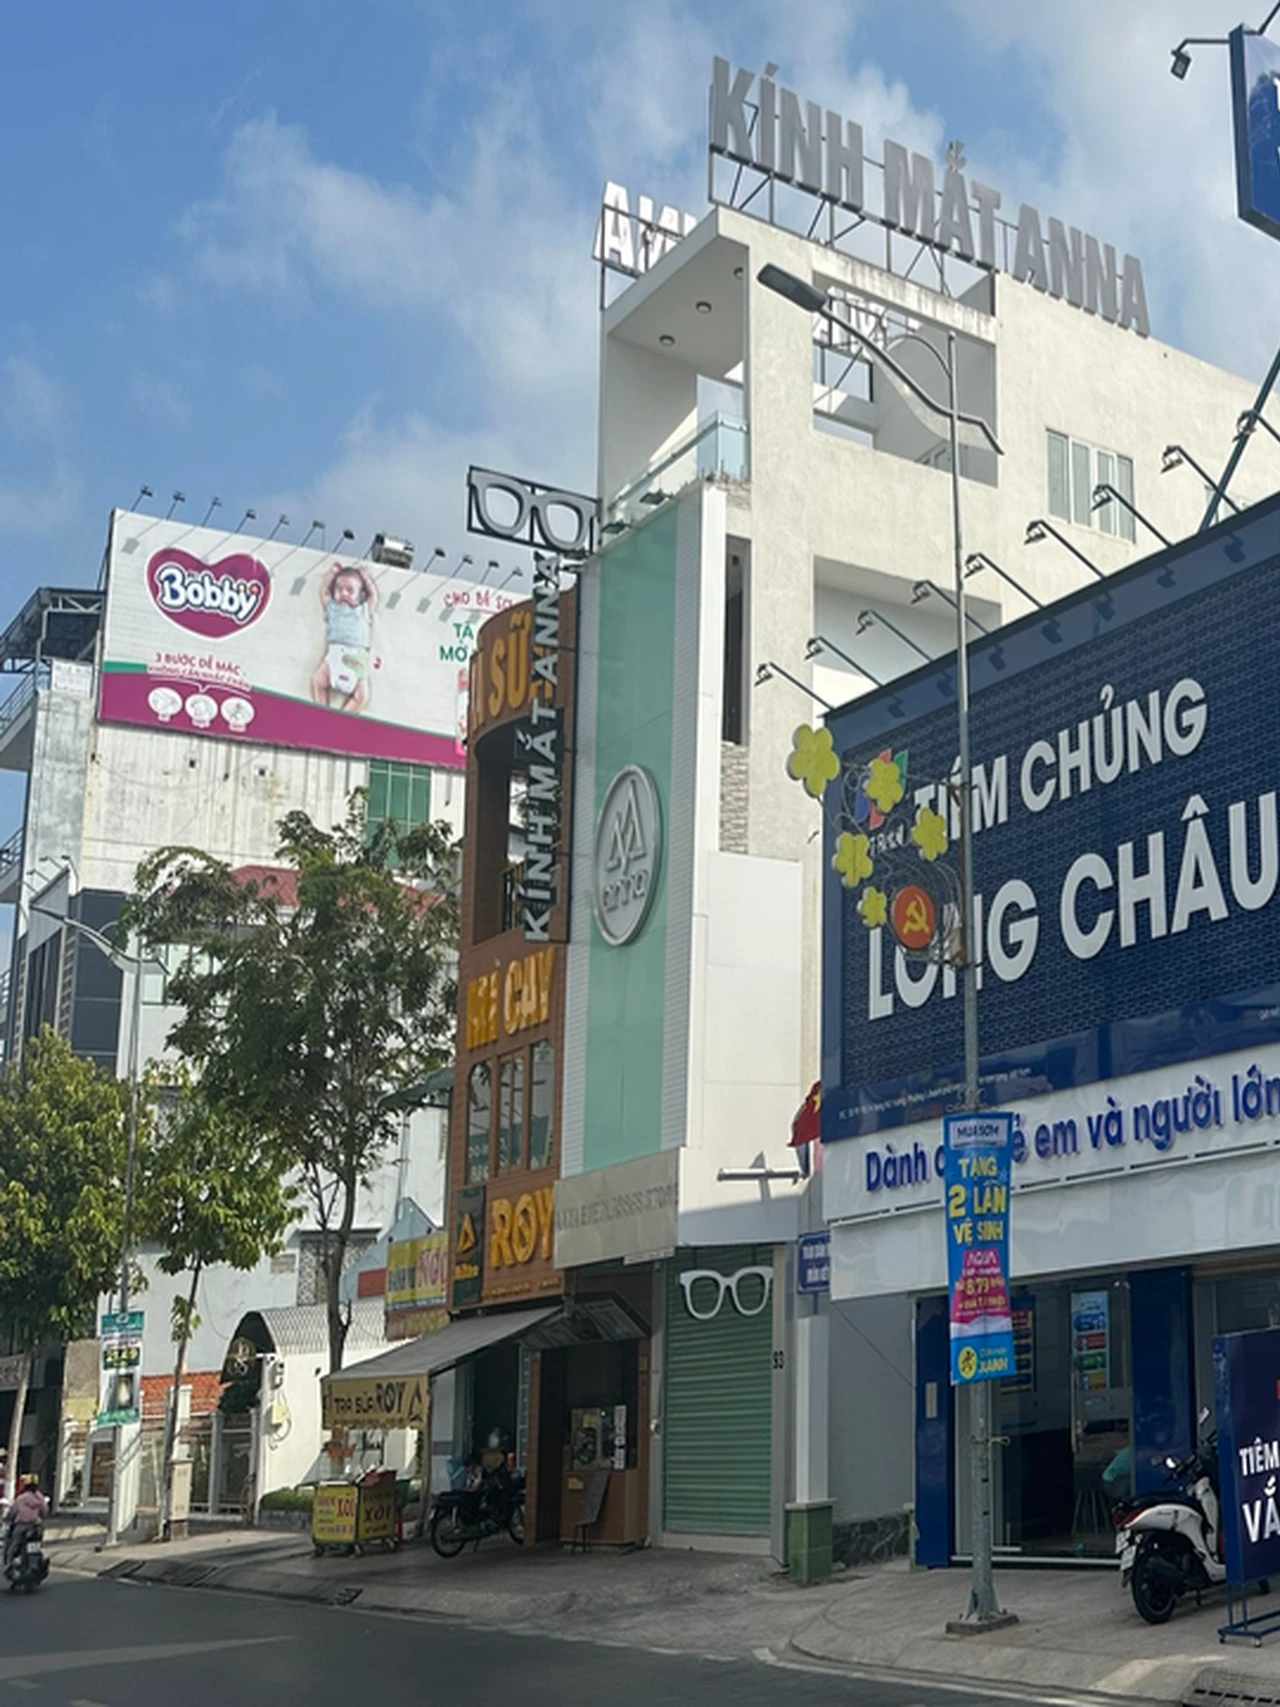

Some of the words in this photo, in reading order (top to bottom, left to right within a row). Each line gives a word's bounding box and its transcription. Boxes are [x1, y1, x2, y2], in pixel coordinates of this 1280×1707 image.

[710, 55, 864, 202] KÍNH
[883, 139, 1002, 271] MẮT
[1013, 204, 1151, 338] ANNA
[159, 565, 260, 621] Bobby
[1020, 678, 1208, 812] CHỦNG
[516, 819, 552, 942] KÍNH
[1060, 792, 1279, 960] CHÂU
[866, 1142, 928, 1192] Dành
[1034, 1118, 1079, 1159] em
[1087, 1096, 1125, 1149] và
[1133, 1074, 1223, 1151] người
[949, 1184, 968, 1218] 2
[977, 1219, 1004, 1242] SINH
[1239, 1437, 1280, 1477] TIÊM
